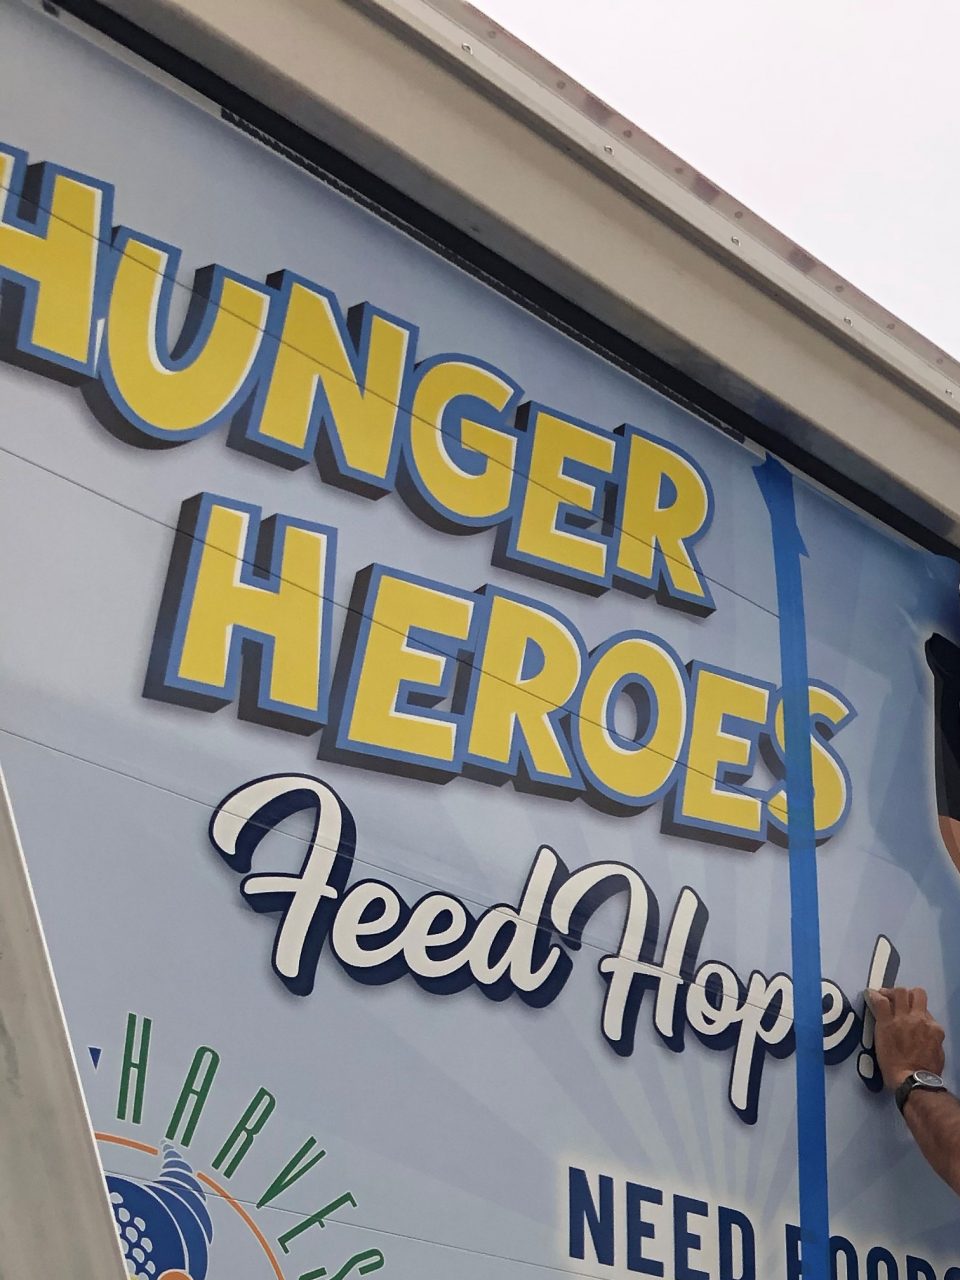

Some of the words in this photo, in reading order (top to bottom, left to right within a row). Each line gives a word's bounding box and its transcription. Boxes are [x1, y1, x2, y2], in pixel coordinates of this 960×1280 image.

[0, 142, 717, 614] HUNGER
[148, 494, 857, 852] HEROES
[209, 772, 572, 1008] Feed
[553, 860, 900, 1125] Hope!
